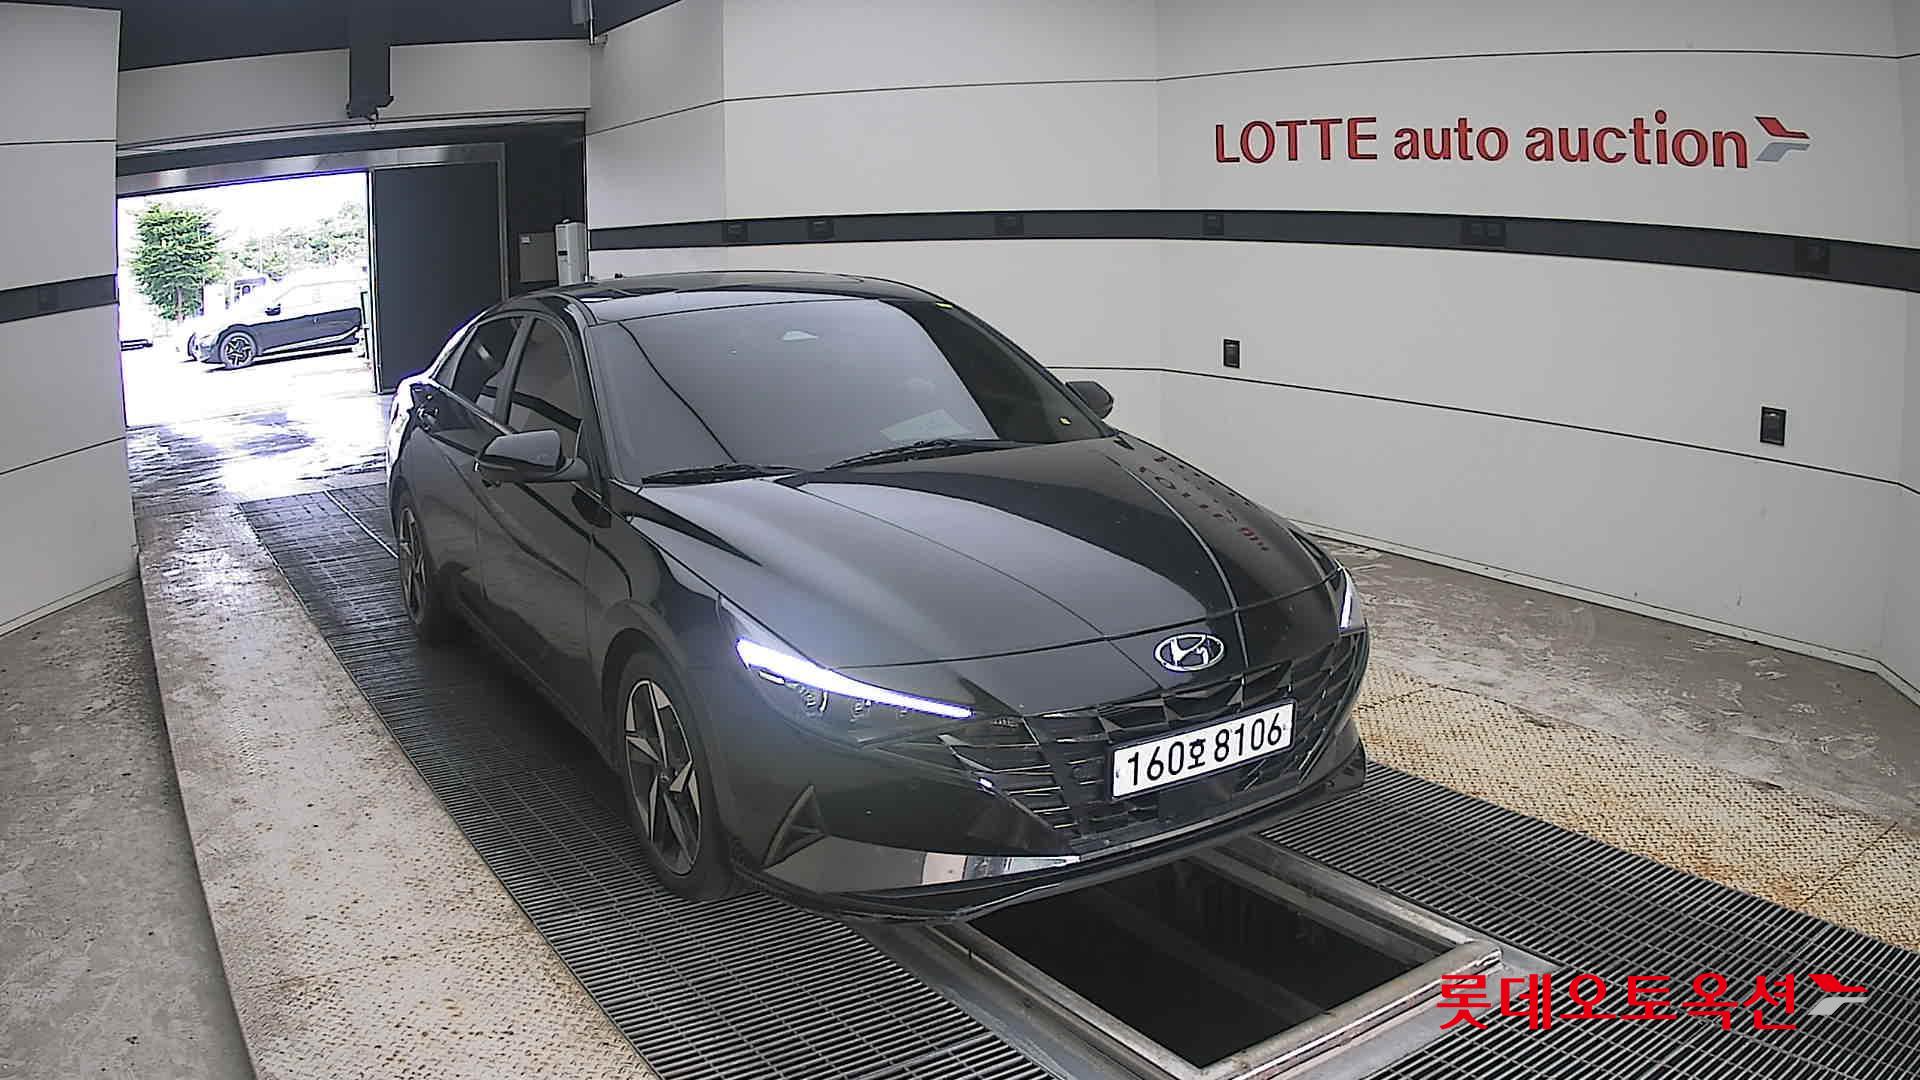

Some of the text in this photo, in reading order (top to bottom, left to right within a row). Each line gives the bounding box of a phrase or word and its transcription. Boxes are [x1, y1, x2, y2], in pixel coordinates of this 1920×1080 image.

[1215, 110, 1748, 168] LOTTE auto auction
[1128, 713, 1282, 786] 160호 8106
